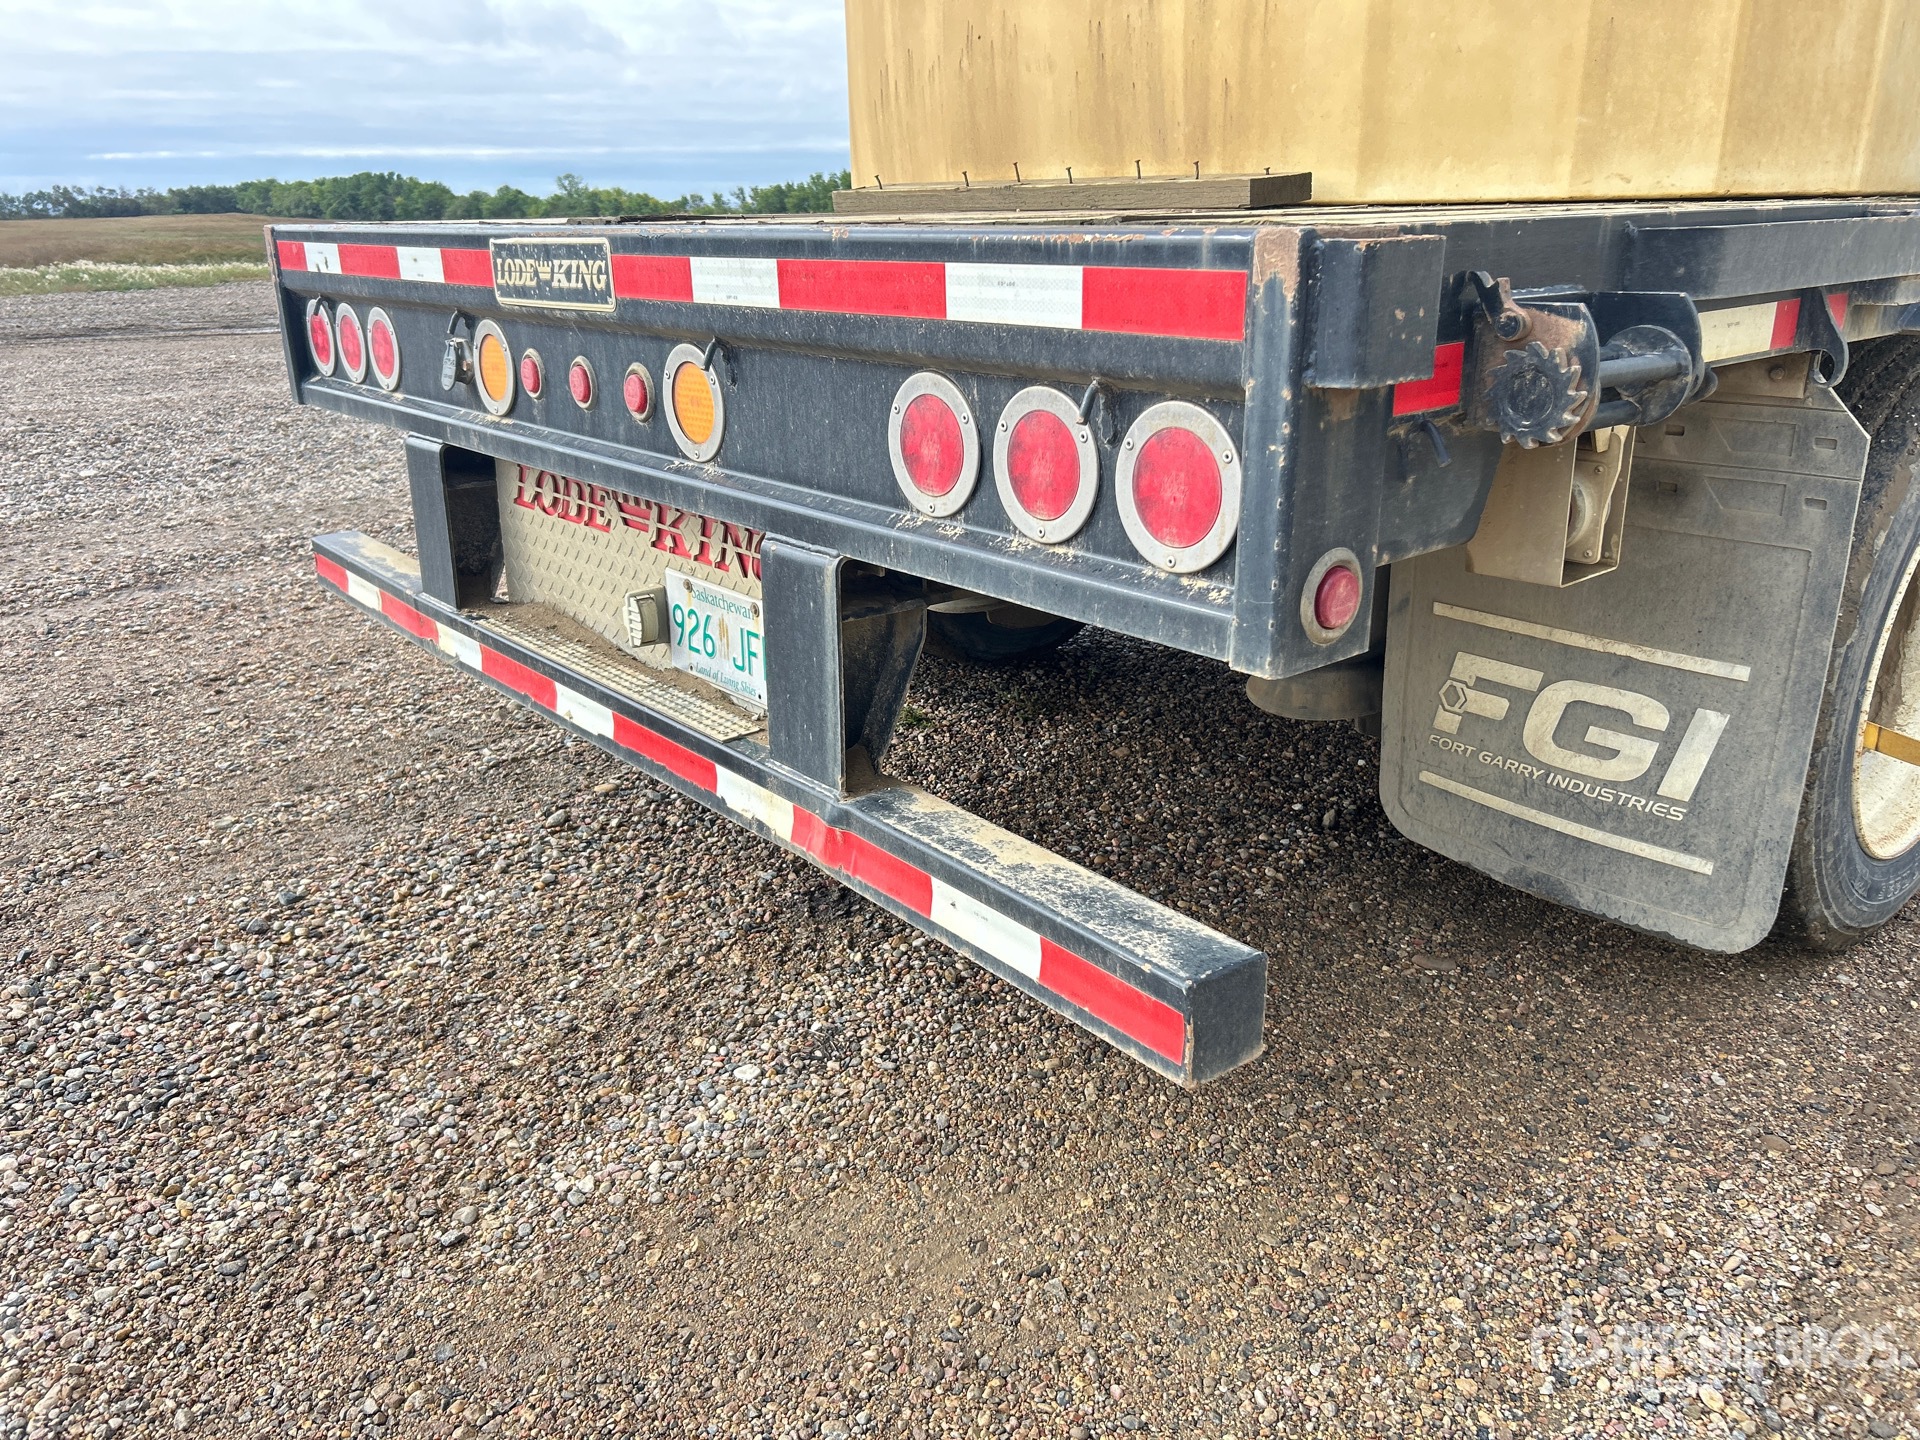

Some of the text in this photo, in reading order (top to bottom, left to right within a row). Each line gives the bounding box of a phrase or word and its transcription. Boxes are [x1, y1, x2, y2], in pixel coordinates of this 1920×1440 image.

[497, 259, 607, 291] LODE KING
[514, 463, 764, 581] LODE KIN
[691, 584, 754, 620] Saskatchewan
[672, 603, 767, 681] 926 JF
[695, 662, 712, 678] Land
[712, 669, 720, 683] of
[1433, 652, 1730, 802] FGI
[1428, 734, 1687, 821] FORT GARRY INDUSTRIES
